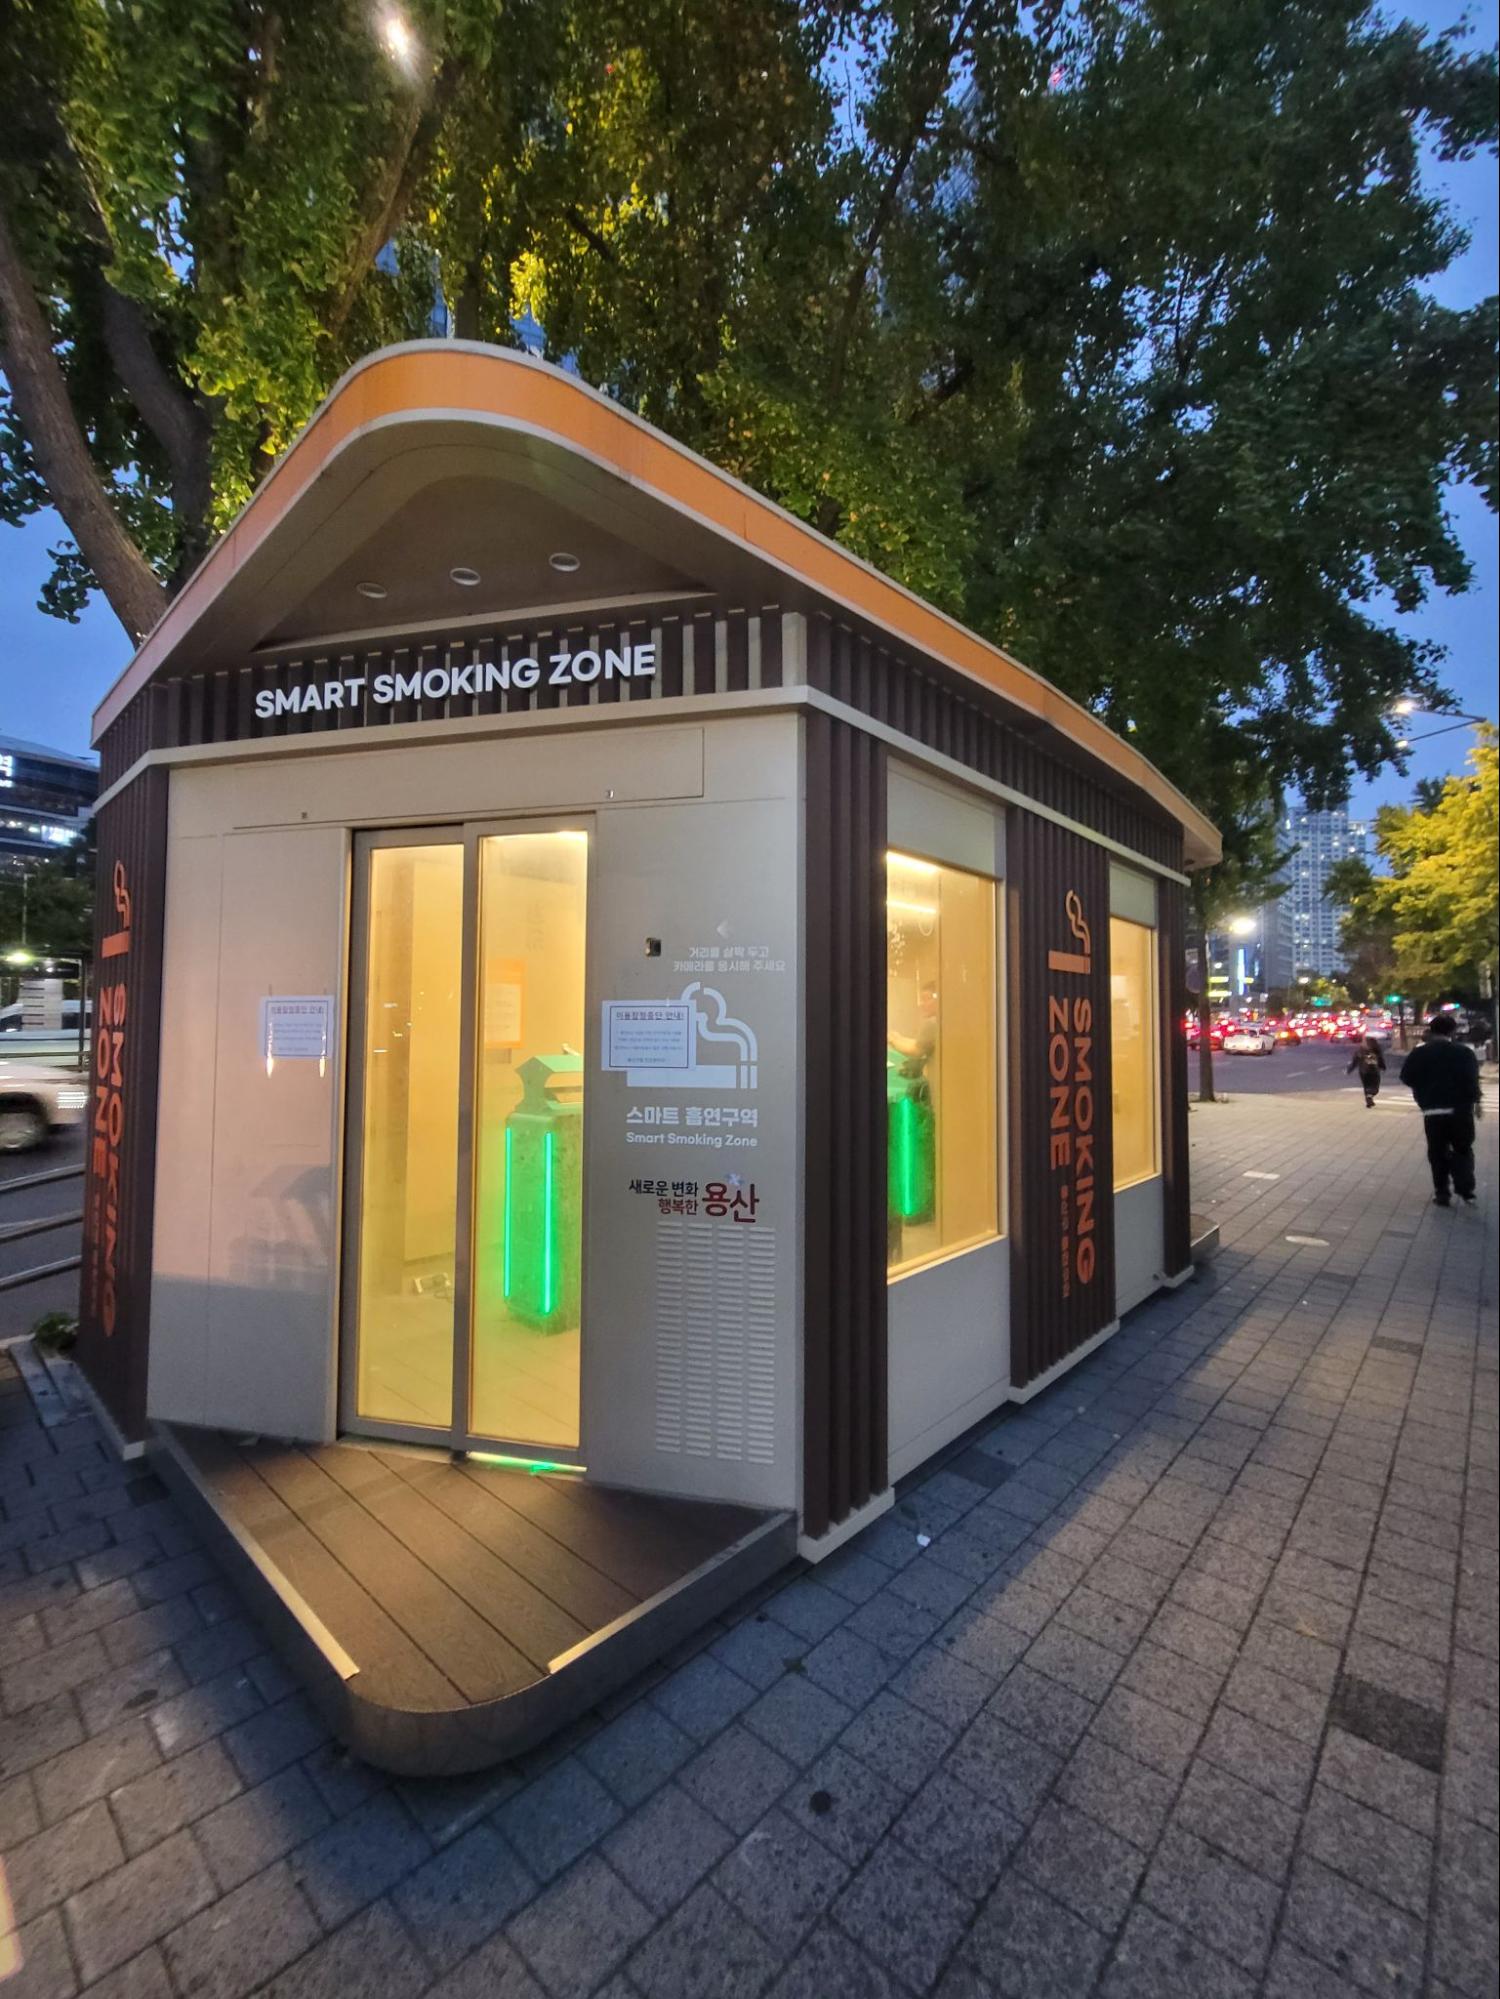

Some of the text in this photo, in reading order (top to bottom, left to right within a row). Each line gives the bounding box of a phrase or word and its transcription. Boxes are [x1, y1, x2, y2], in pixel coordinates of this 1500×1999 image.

[255, 643, 657, 719] SMART SMOKING ZONE
[1049, 995, 1071, 1171] ZONE
[626, 1106, 758, 1128] 스마트 흡연구역
[626, 1132, 758, 1148] Smart Smoking Zone
[1074, 998, 1095, 1285] SMOKING
[628, 1179, 699, 1198] 새로운 변화
[657, 1182, 760, 1223] 행복한 용산
